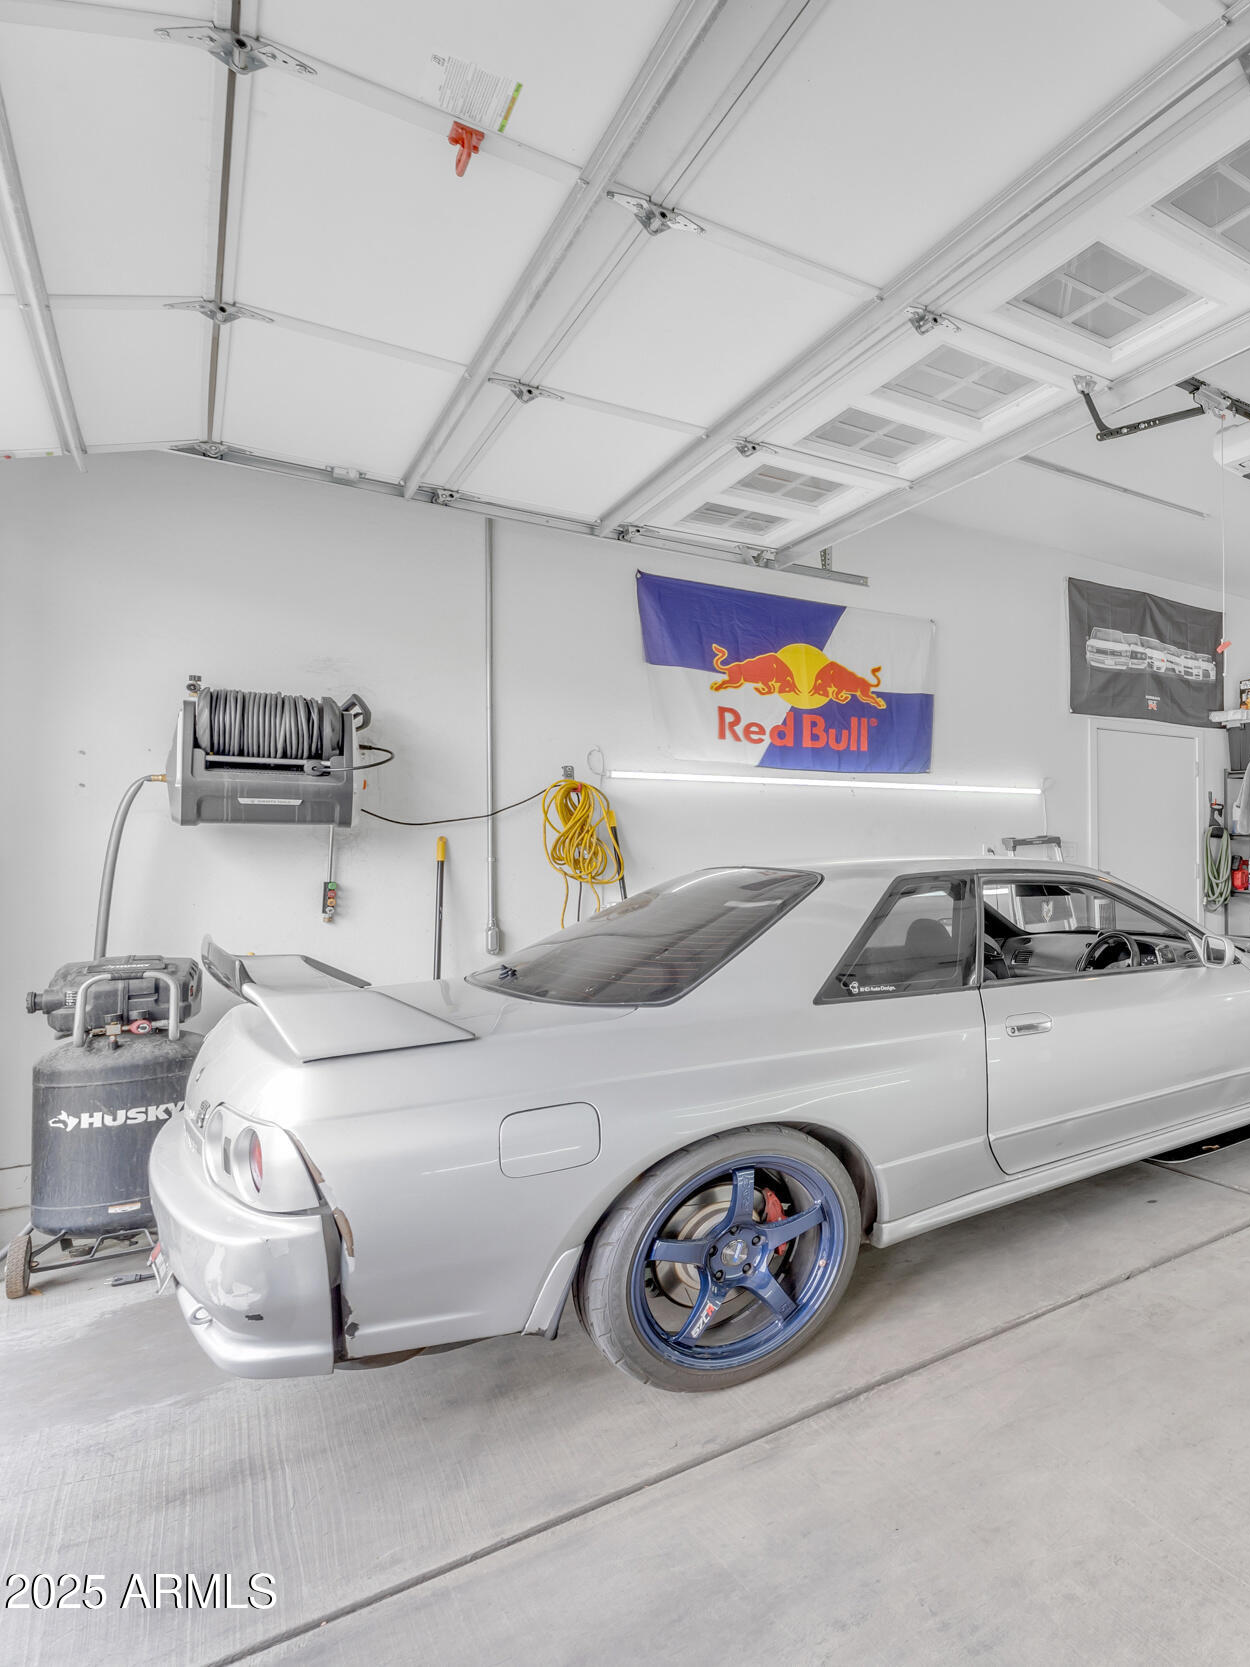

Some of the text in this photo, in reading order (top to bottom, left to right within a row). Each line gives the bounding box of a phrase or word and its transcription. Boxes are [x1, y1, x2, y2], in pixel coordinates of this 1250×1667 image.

[717, 706, 868, 751] Red Bull
[80, 1102, 185, 1129] HUSKY
